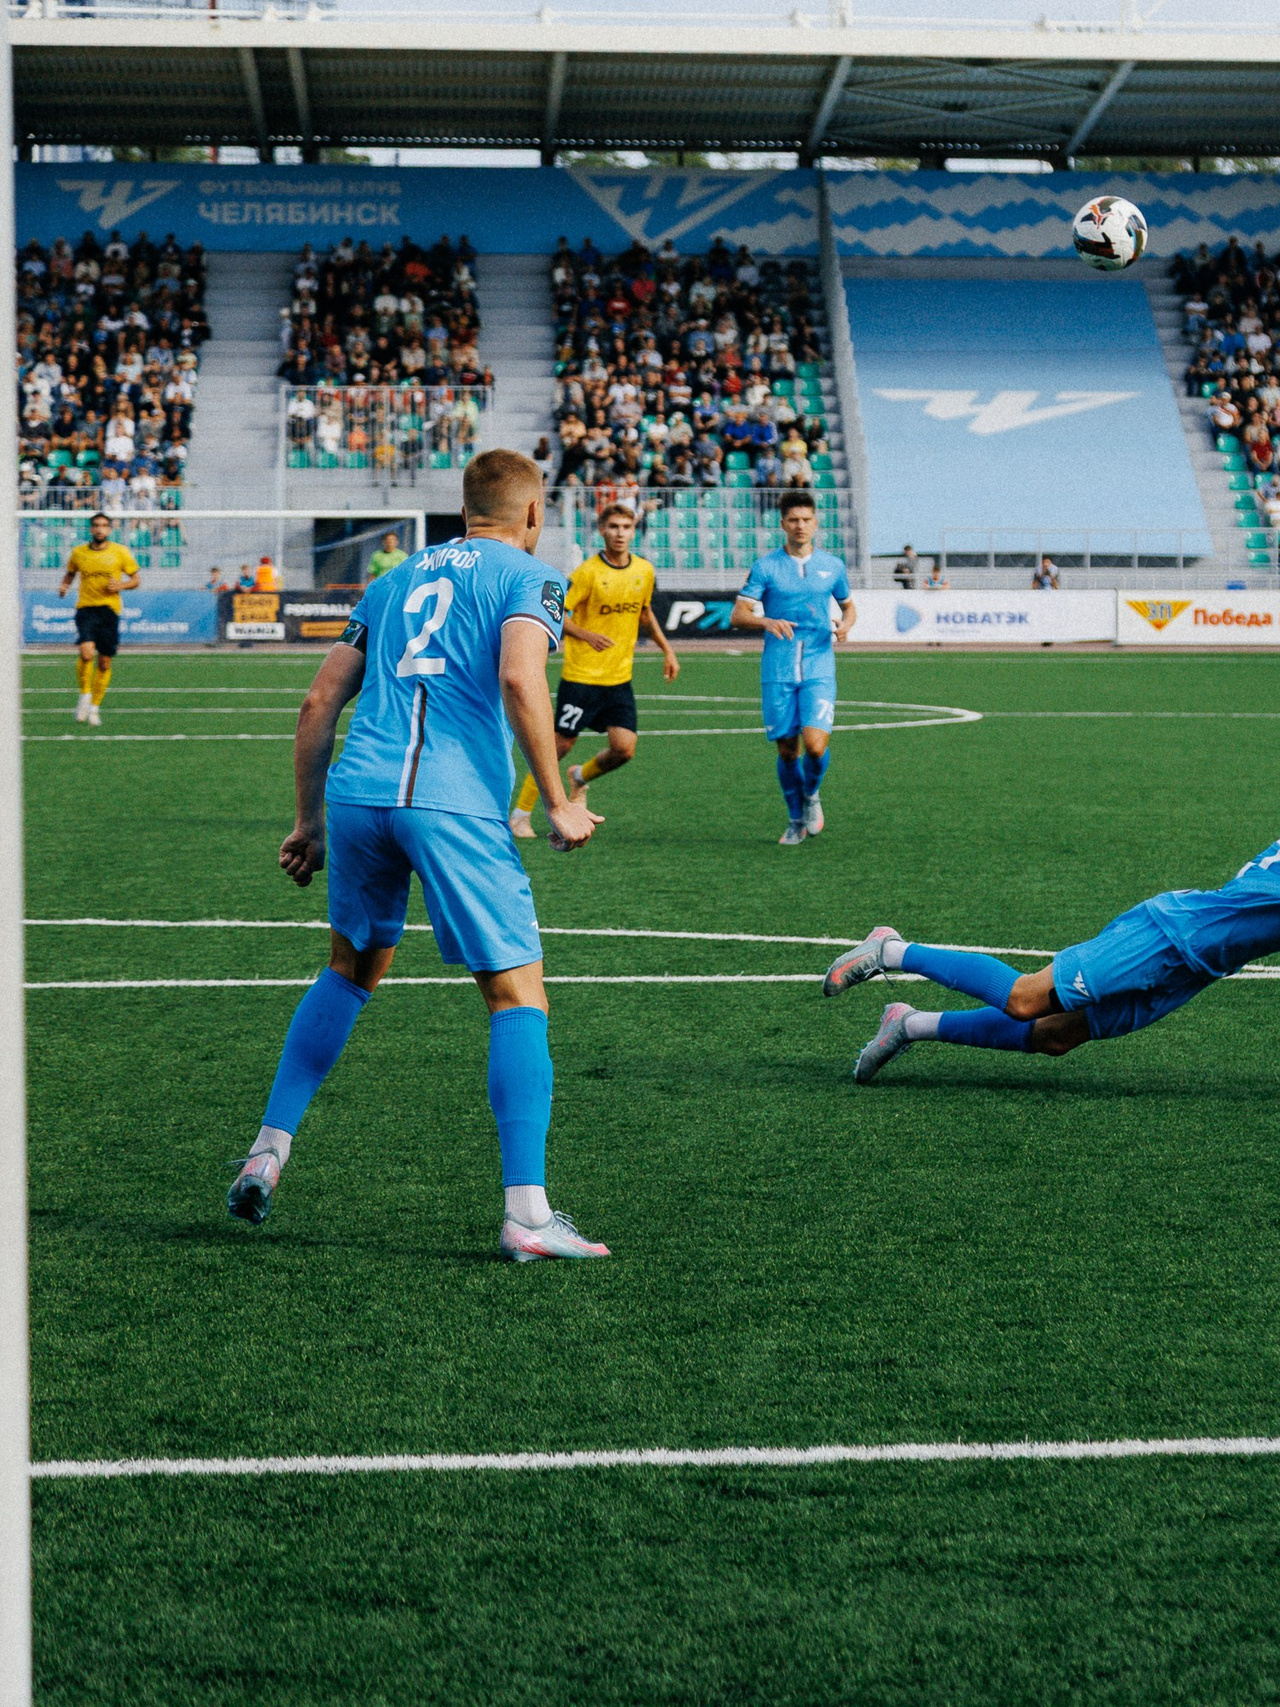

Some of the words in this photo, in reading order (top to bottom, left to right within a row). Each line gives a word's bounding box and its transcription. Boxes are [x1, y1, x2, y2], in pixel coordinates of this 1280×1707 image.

[199, 202, 401, 226] ЧЕЛЯБИНСК
[415, 548, 481, 571] ЖИРОВ
[601, 602, 640, 615] DARS
[936, 611, 1029, 624] НОВАТЭК
[1194, 608, 1272, 628] Победа
[397, 577, 454, 678] 2
[558, 703, 584, 731] 27
